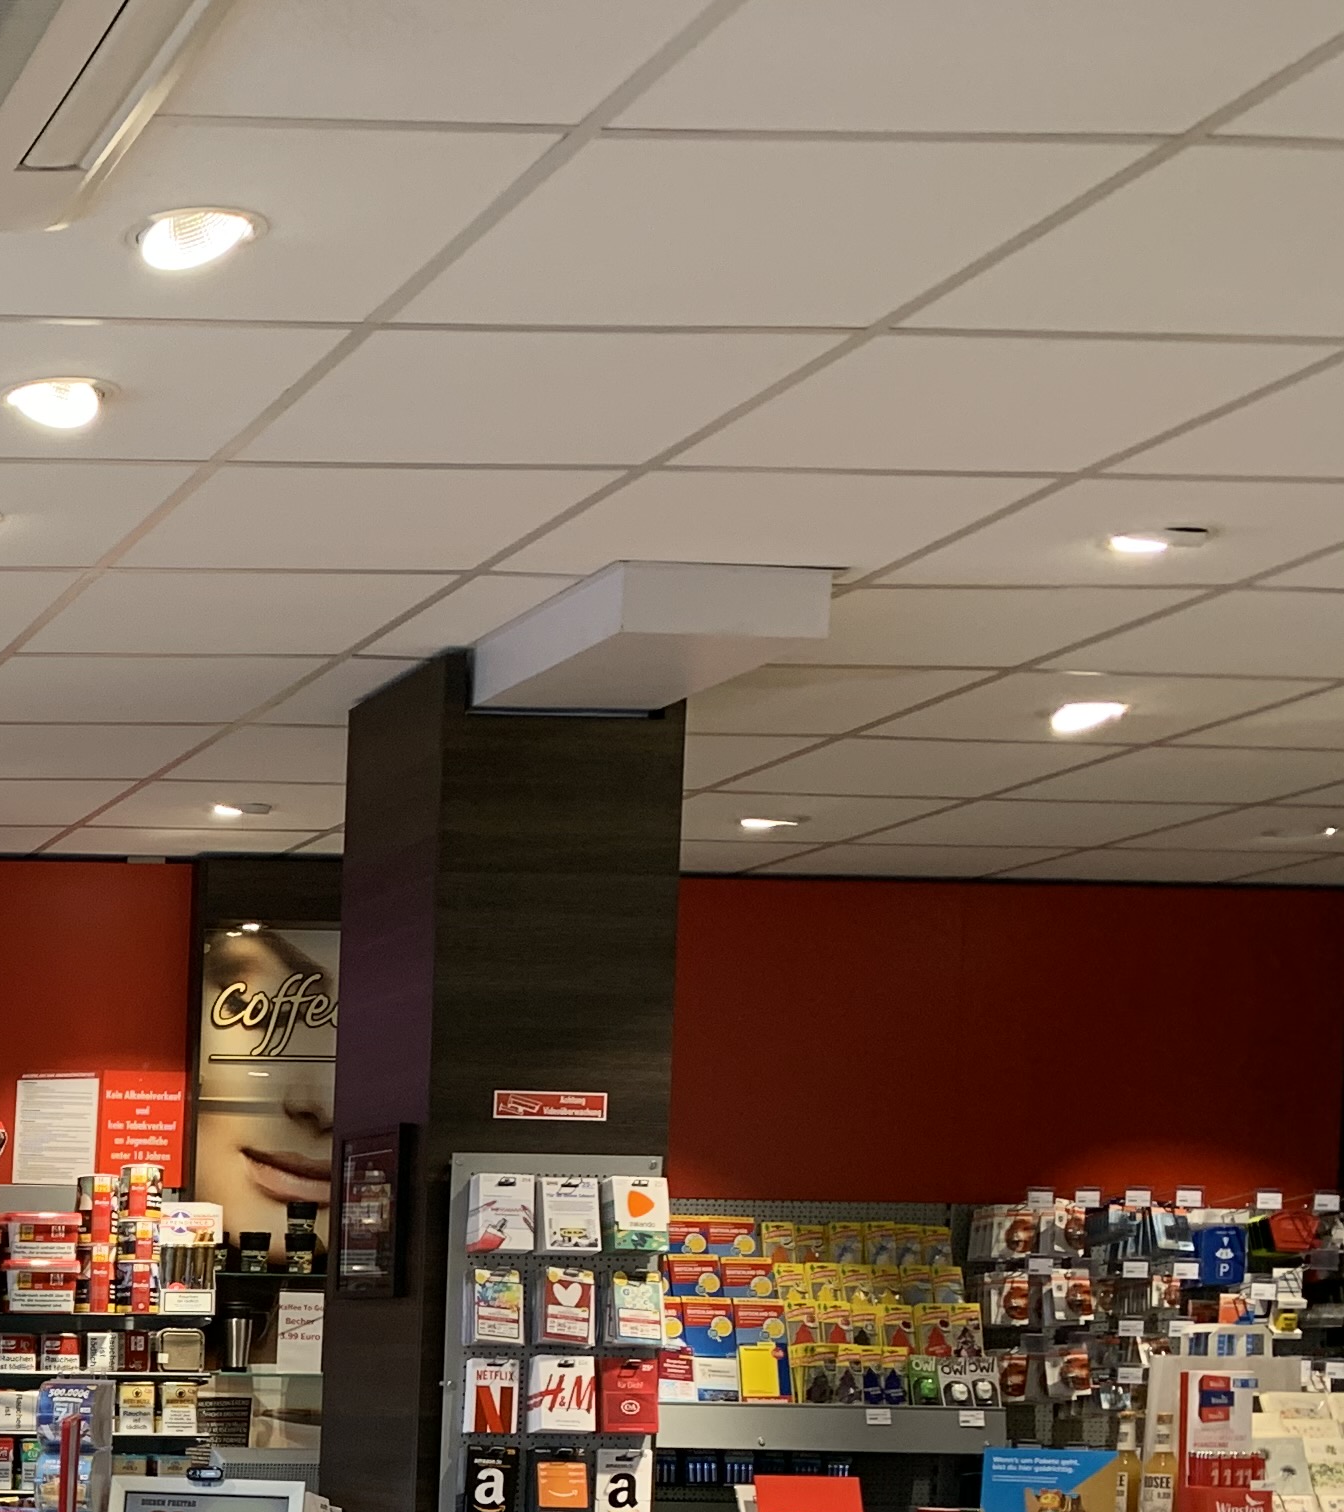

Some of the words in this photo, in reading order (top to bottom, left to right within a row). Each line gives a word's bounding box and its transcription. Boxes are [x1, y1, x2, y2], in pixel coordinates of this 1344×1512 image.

[145, 1151, 171, 1161] Jahren
[1219, 1262, 1229, 1277] P
[476, 1370, 515, 1381] NETFLIX
